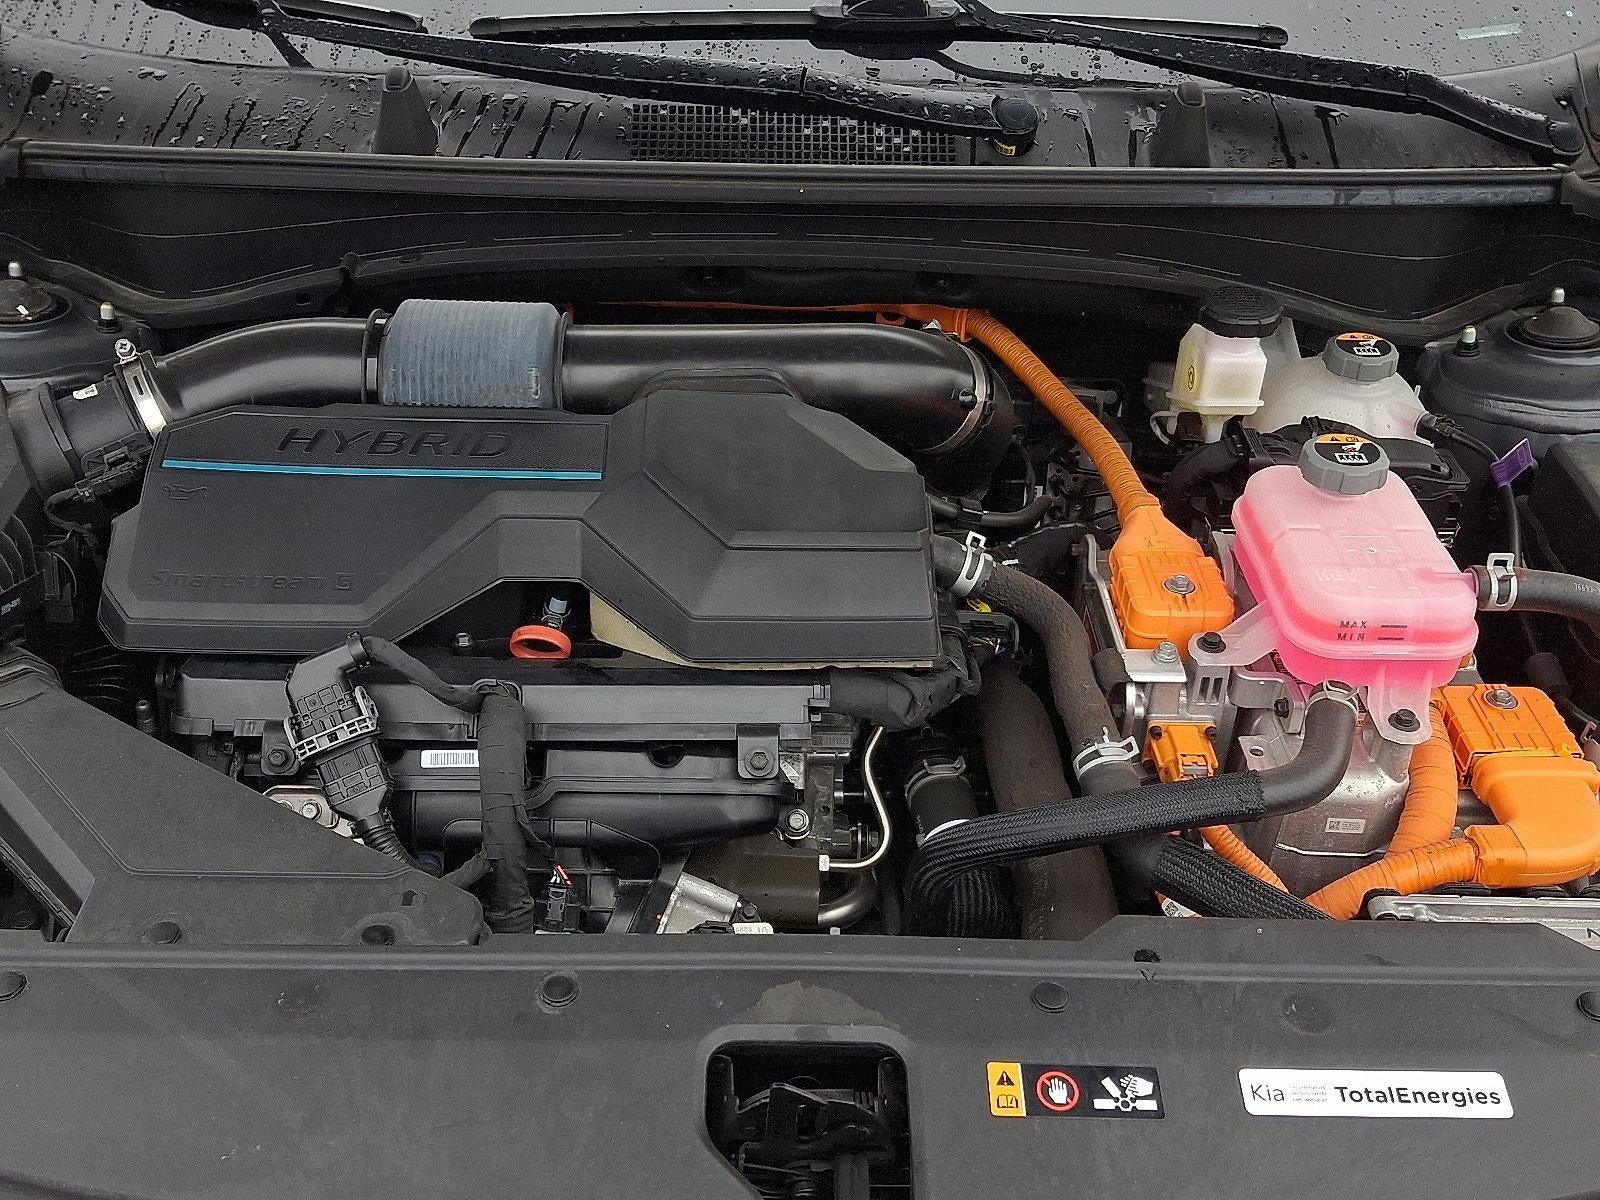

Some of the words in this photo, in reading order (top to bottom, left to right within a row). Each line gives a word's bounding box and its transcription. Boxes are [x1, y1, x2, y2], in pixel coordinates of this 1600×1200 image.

[275, 427, 512, 458] HYBRID
[1339, 620, 1367, 629] MAX
[1337, 632, 1365, 641] MIN
[1250, 1084, 1285, 1102] Kia
[1333, 1086, 1501, 1107] TotalEnergies
